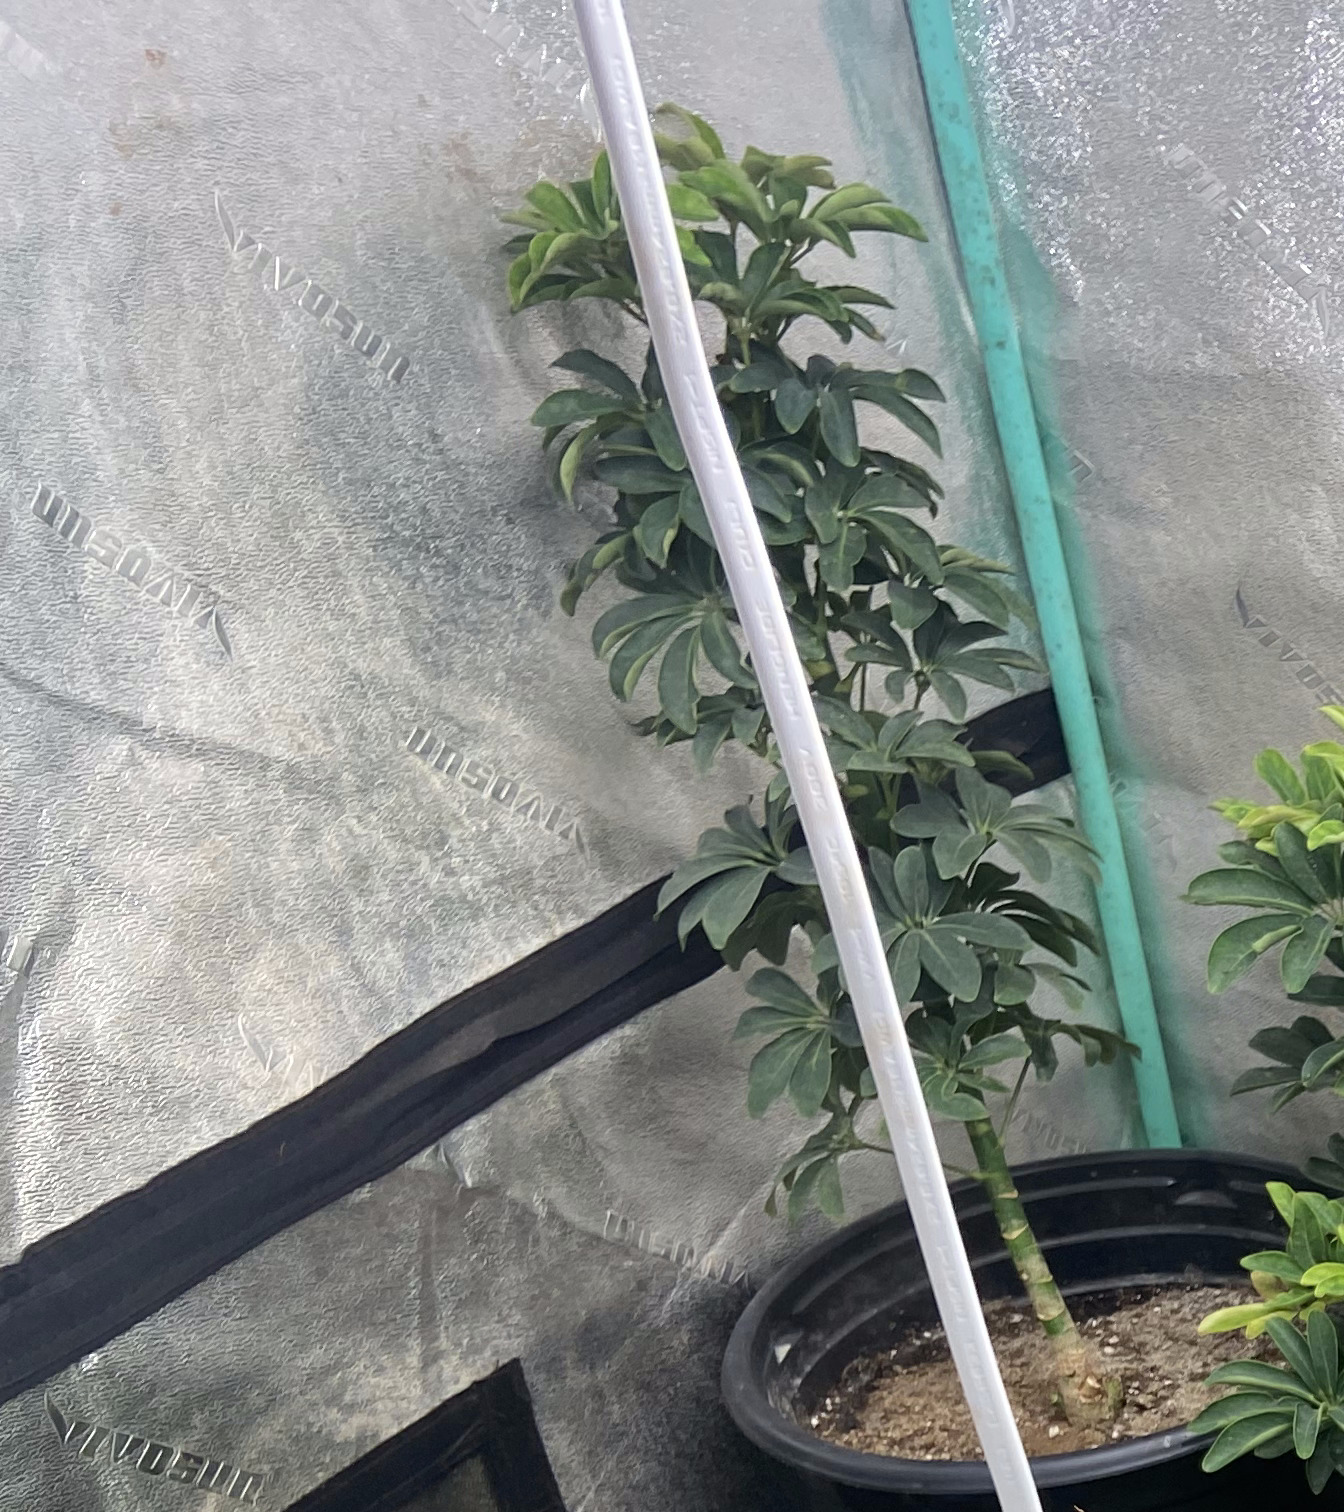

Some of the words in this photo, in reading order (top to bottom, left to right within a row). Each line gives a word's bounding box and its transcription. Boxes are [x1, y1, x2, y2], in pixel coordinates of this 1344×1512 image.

[214, 190, 410, 384] VIVOSUN
[31, 481, 232, 661] VIVOSUN
[405, 726, 590, 864] VIVOSUN
[45, 1391, 263, 1504] VIVOSUN
